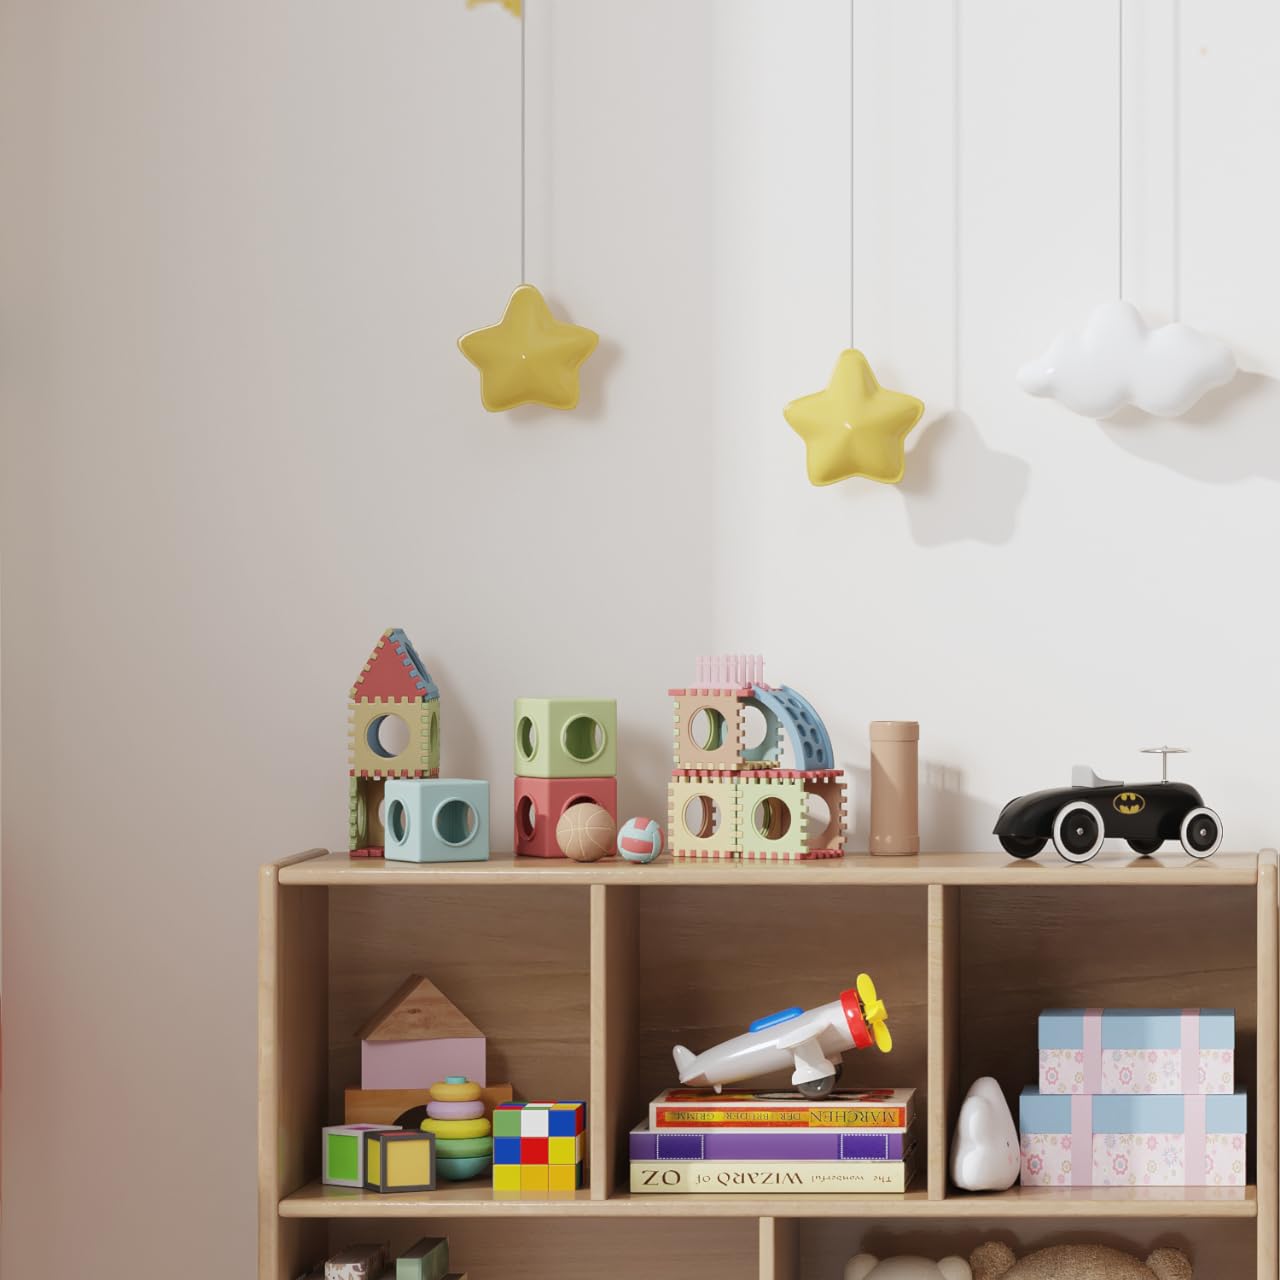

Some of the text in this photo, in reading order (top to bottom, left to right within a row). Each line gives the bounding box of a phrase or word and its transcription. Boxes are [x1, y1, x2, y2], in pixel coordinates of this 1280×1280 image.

[780, 1112, 801, 1120] DER
[811, 1111, 897, 1125] MÄRCHEN
[641, 1169, 681, 1186] OZ
[696, 1174, 711, 1184] of
[873, 1175, 892, 1183] The
